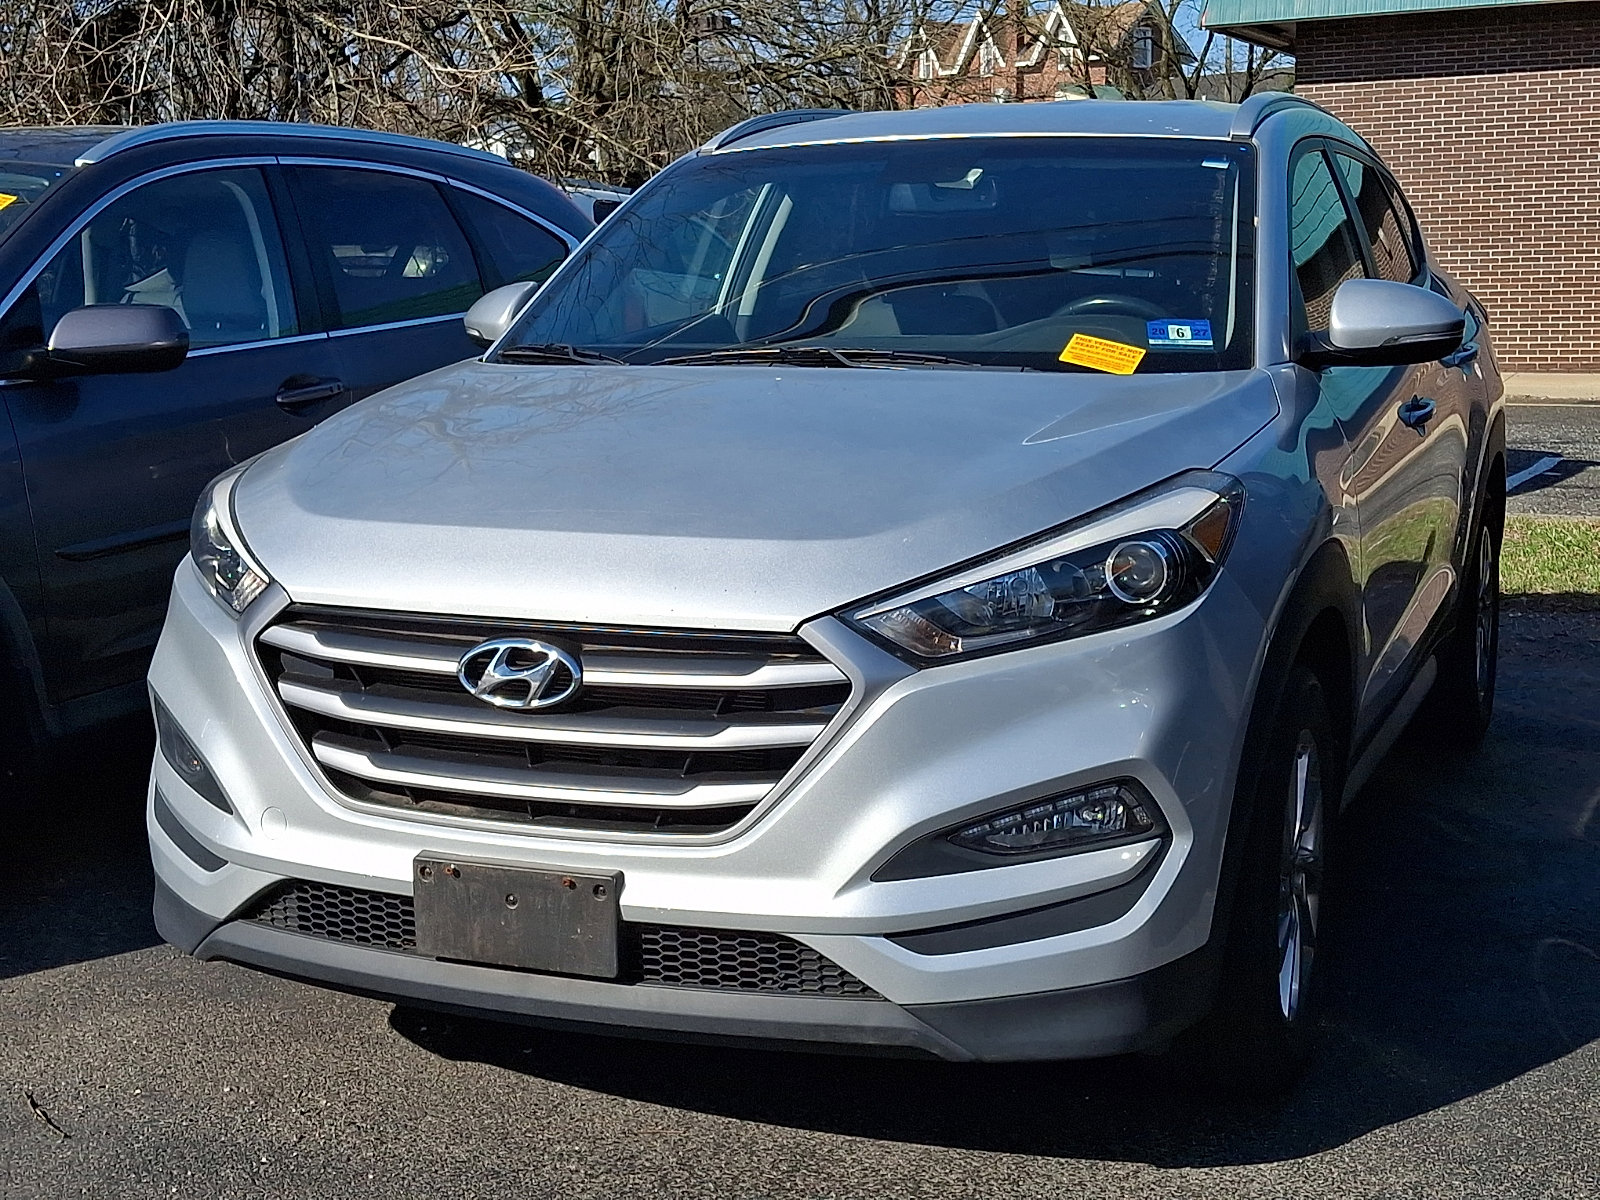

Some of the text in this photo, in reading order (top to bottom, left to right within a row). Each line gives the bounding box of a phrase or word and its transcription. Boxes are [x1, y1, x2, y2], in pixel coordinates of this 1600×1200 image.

[1152, 327, 1208, 338] 20 6 27
[1075, 341, 1100, 350] READY
[1118, 351, 1137, 359] SALE
[1094, 340, 1125, 351] VEHICLE
[1127, 348, 1144, 356] NOT
